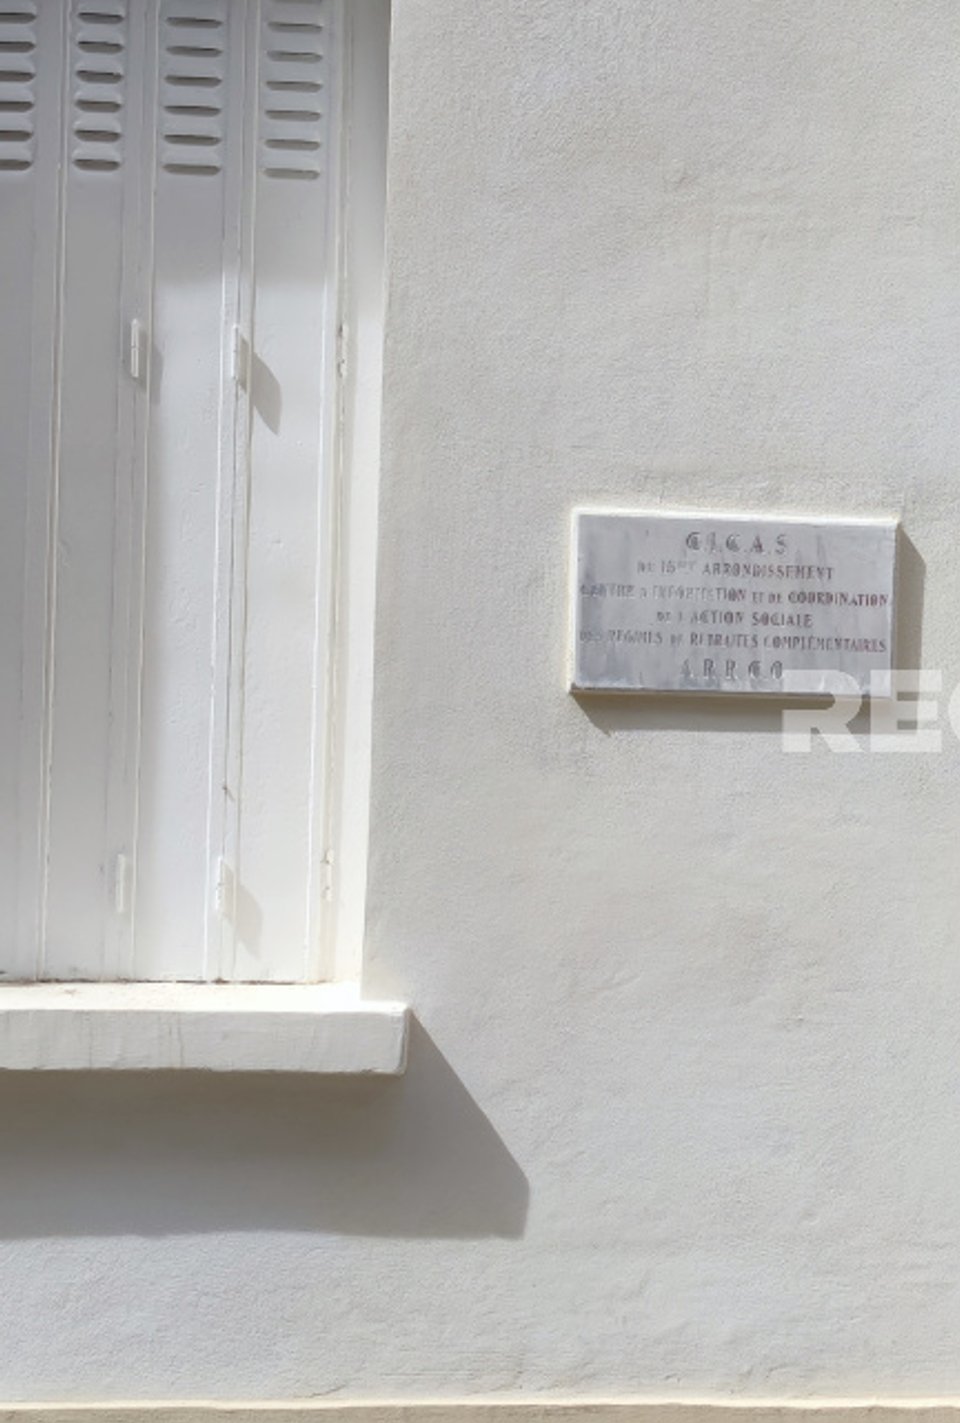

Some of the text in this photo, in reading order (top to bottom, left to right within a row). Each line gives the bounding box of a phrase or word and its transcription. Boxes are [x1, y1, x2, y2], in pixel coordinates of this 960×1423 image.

[702, 562, 833, 580] ARRONDISSEMENT
[768, 593, 782, 604] DE
[788, 591, 888, 608] COORDINATION
[752, 611, 813, 628] SOCIALE
[690, 632, 759, 649] RETRAITES
